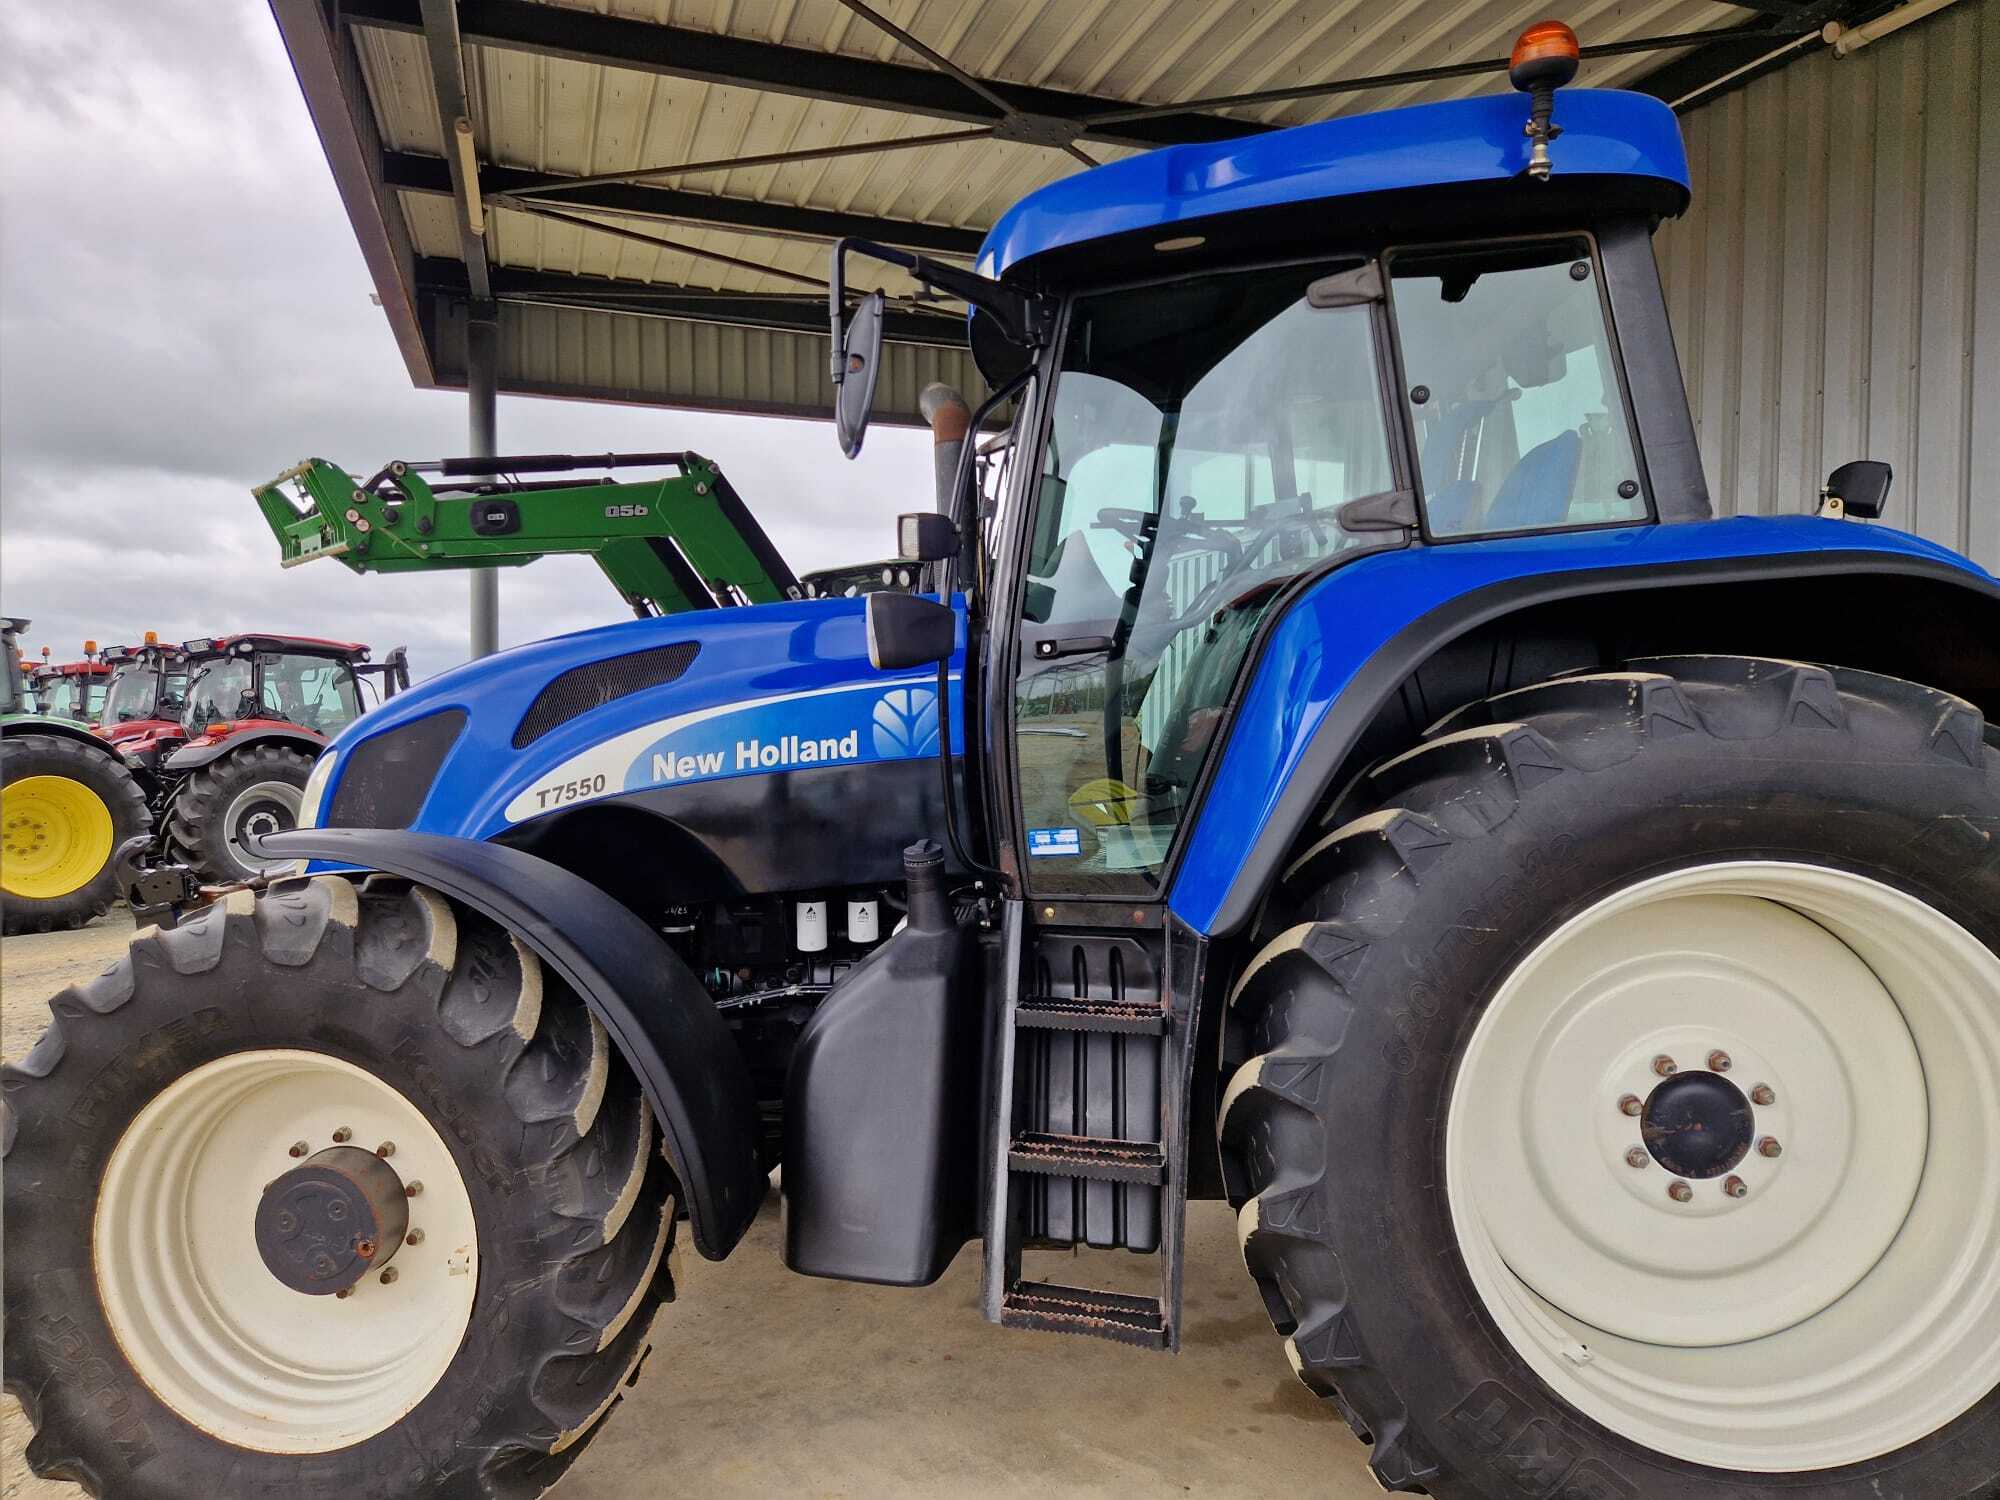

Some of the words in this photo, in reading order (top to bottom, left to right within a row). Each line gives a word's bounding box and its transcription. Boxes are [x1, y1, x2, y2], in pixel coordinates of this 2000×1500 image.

[652, 750, 725, 781] New
[735, 730, 858, 770] Holland
[536, 774, 606, 809] T7550
